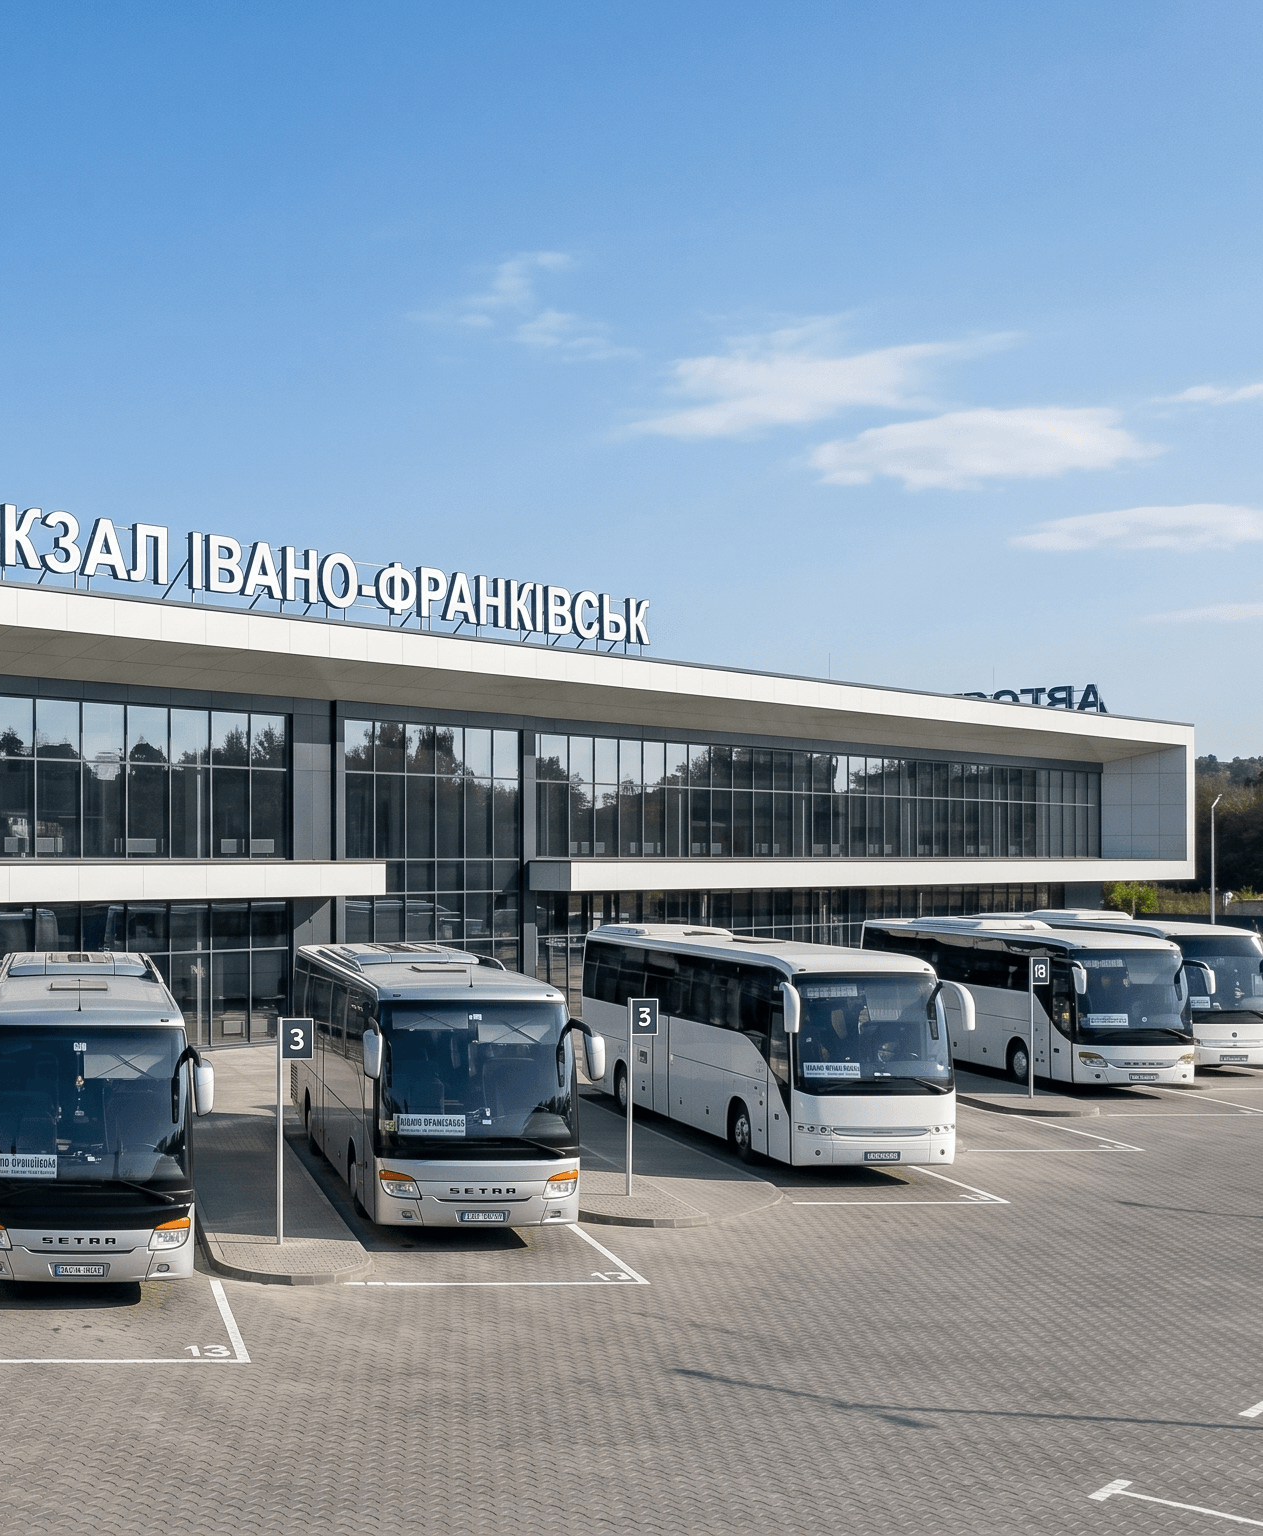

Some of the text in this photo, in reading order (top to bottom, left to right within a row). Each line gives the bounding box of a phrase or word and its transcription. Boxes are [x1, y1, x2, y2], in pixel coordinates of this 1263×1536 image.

[187, 530, 651, 645] ІВАНО-ФРАНКІВСЬК
[1034, 964, 1046, 978] 18
[638, 1007, 652, 1027] 3
[289, 1028, 305, 1050] 3
[449, 1187, 516, 1195] SETRA
[41, 1236, 116, 1245] SETRA
[184, 1344, 231, 1357] 13
